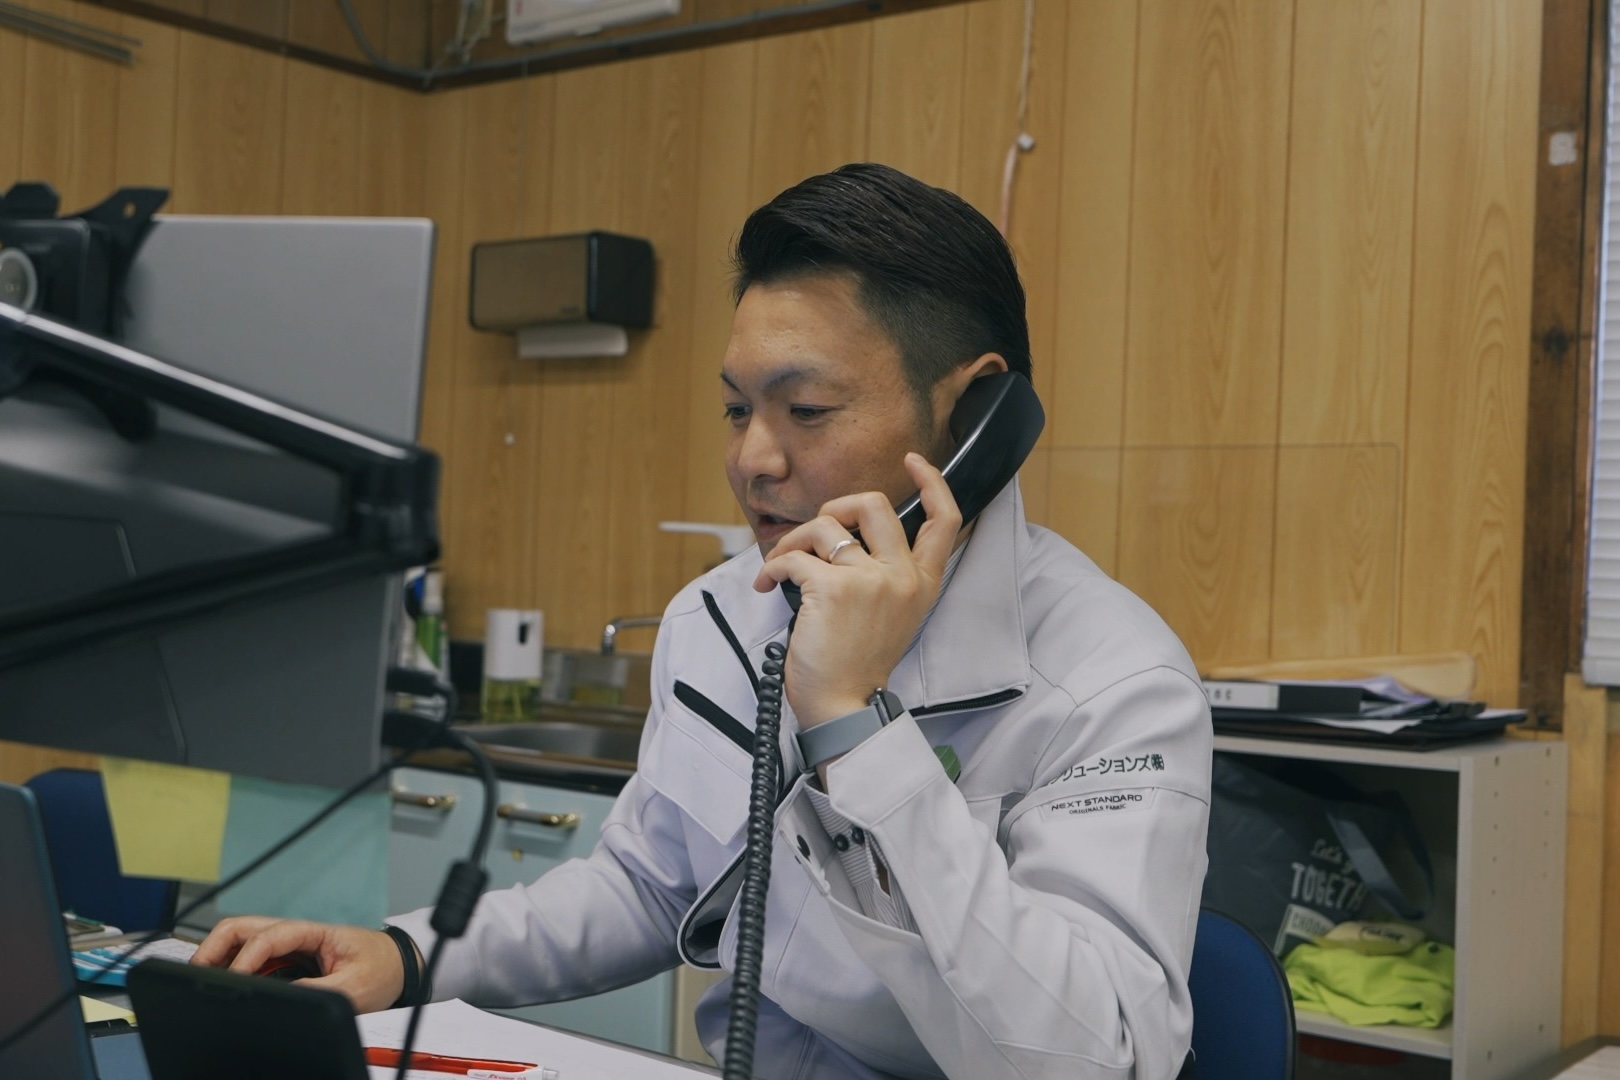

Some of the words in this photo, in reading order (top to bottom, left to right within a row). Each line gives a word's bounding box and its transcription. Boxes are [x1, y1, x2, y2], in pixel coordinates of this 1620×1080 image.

[1051, 800, 1082, 811] NEXT
[1084, 794, 1142, 806] STANDARD
[1069, 806, 1104, 815] ORIGINALS
[1105, 803, 1126, 811] FABRIC
